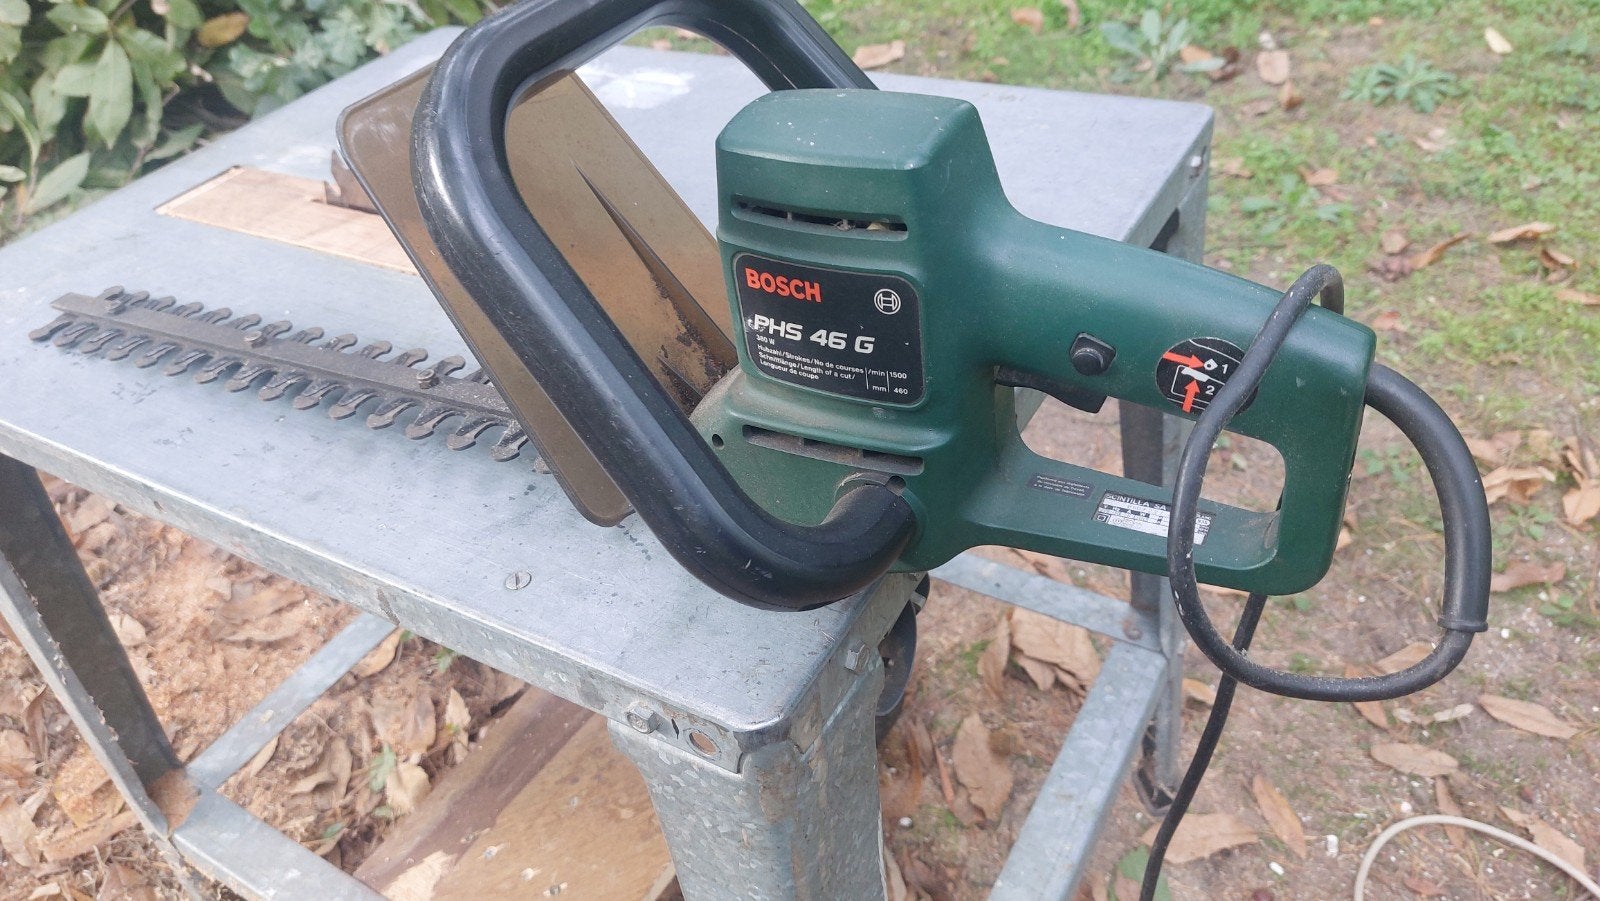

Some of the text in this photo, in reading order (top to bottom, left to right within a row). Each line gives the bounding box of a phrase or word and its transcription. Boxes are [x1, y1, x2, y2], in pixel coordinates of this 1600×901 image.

[745, 268, 821, 302] BOSCH
[754, 313, 875, 354] PHS 46 G
[789, 367, 798, 375] de
[798, 371, 820, 380] coupe
[835, 364, 864, 374] courses
[868, 368, 886, 377] /min
[1221, 363, 1229, 374] 1
[889, 371, 908, 379] 1500
[893, 387, 909, 395] 460
[1205, 385, 1215, 395] 2
[1105, 493, 1150, 507] SCINTILLA
[1153, 502, 1168, 511] SA
